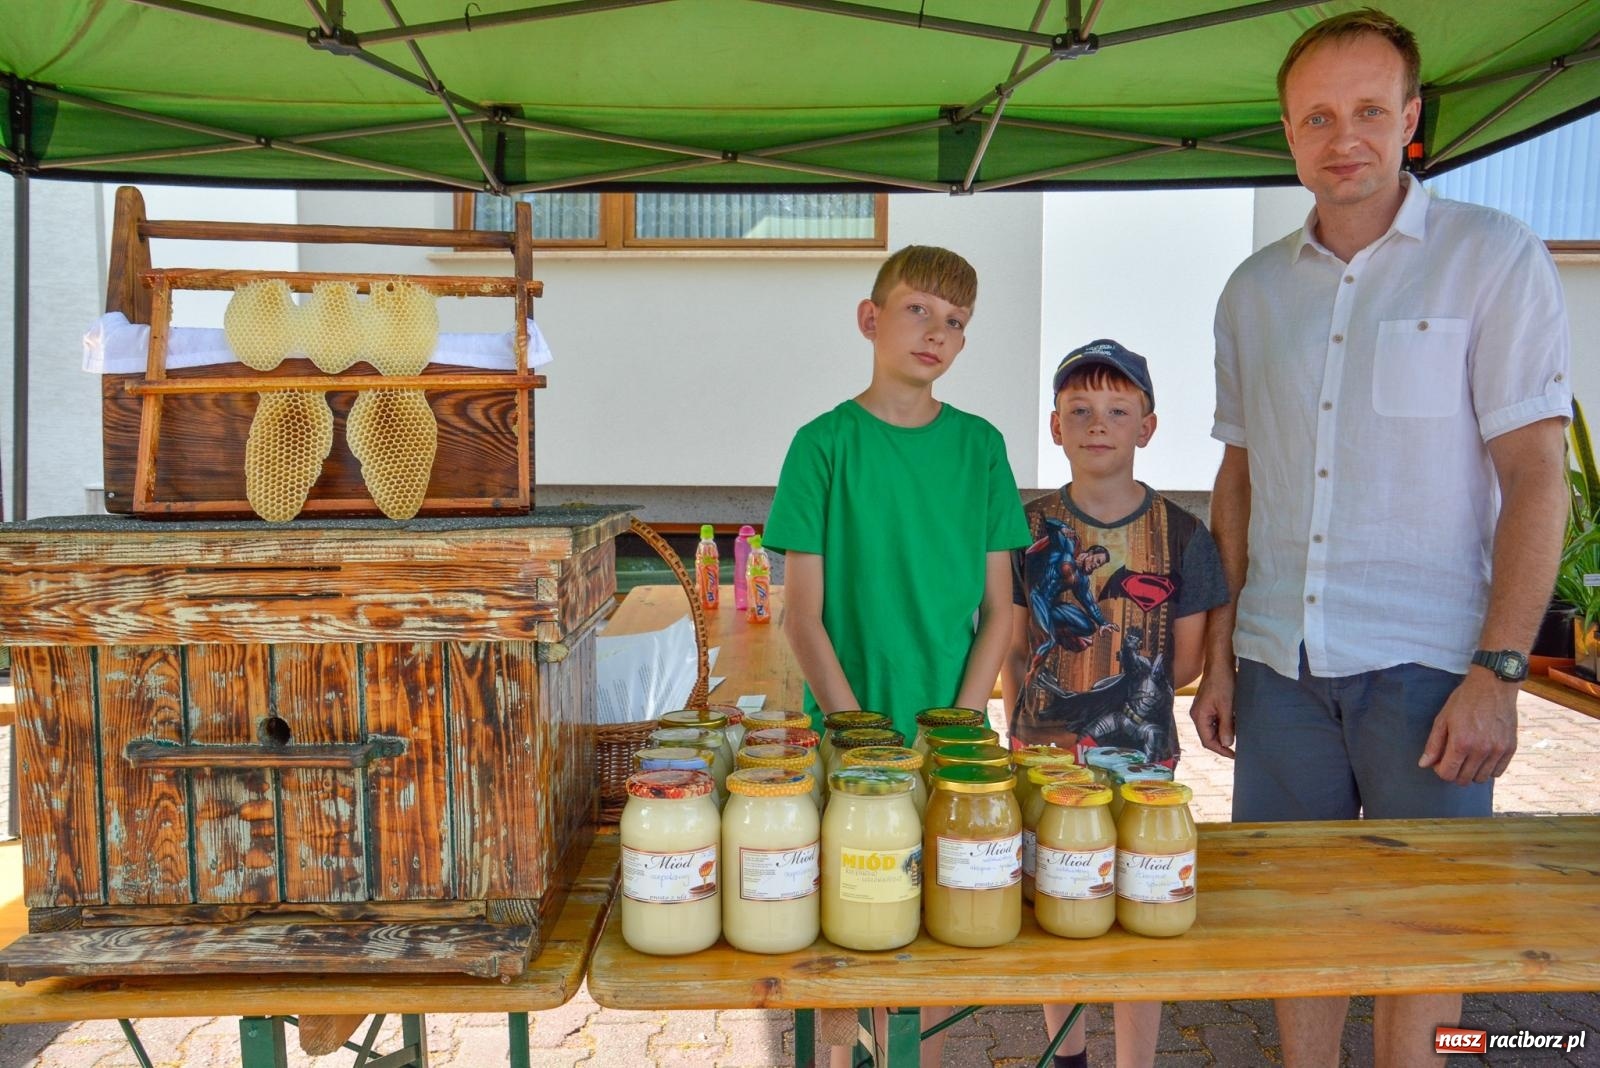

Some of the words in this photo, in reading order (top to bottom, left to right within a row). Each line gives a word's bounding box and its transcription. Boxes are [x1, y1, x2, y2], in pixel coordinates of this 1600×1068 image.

[970, 840, 1014, 857] Miód
[645, 854, 695, 869] Miód
[776, 847, 816, 867] Miód
[842, 853, 896, 871] MIÓD
[1047, 852, 1096, 867] Miód
[1126, 855, 1175, 870] Miód
